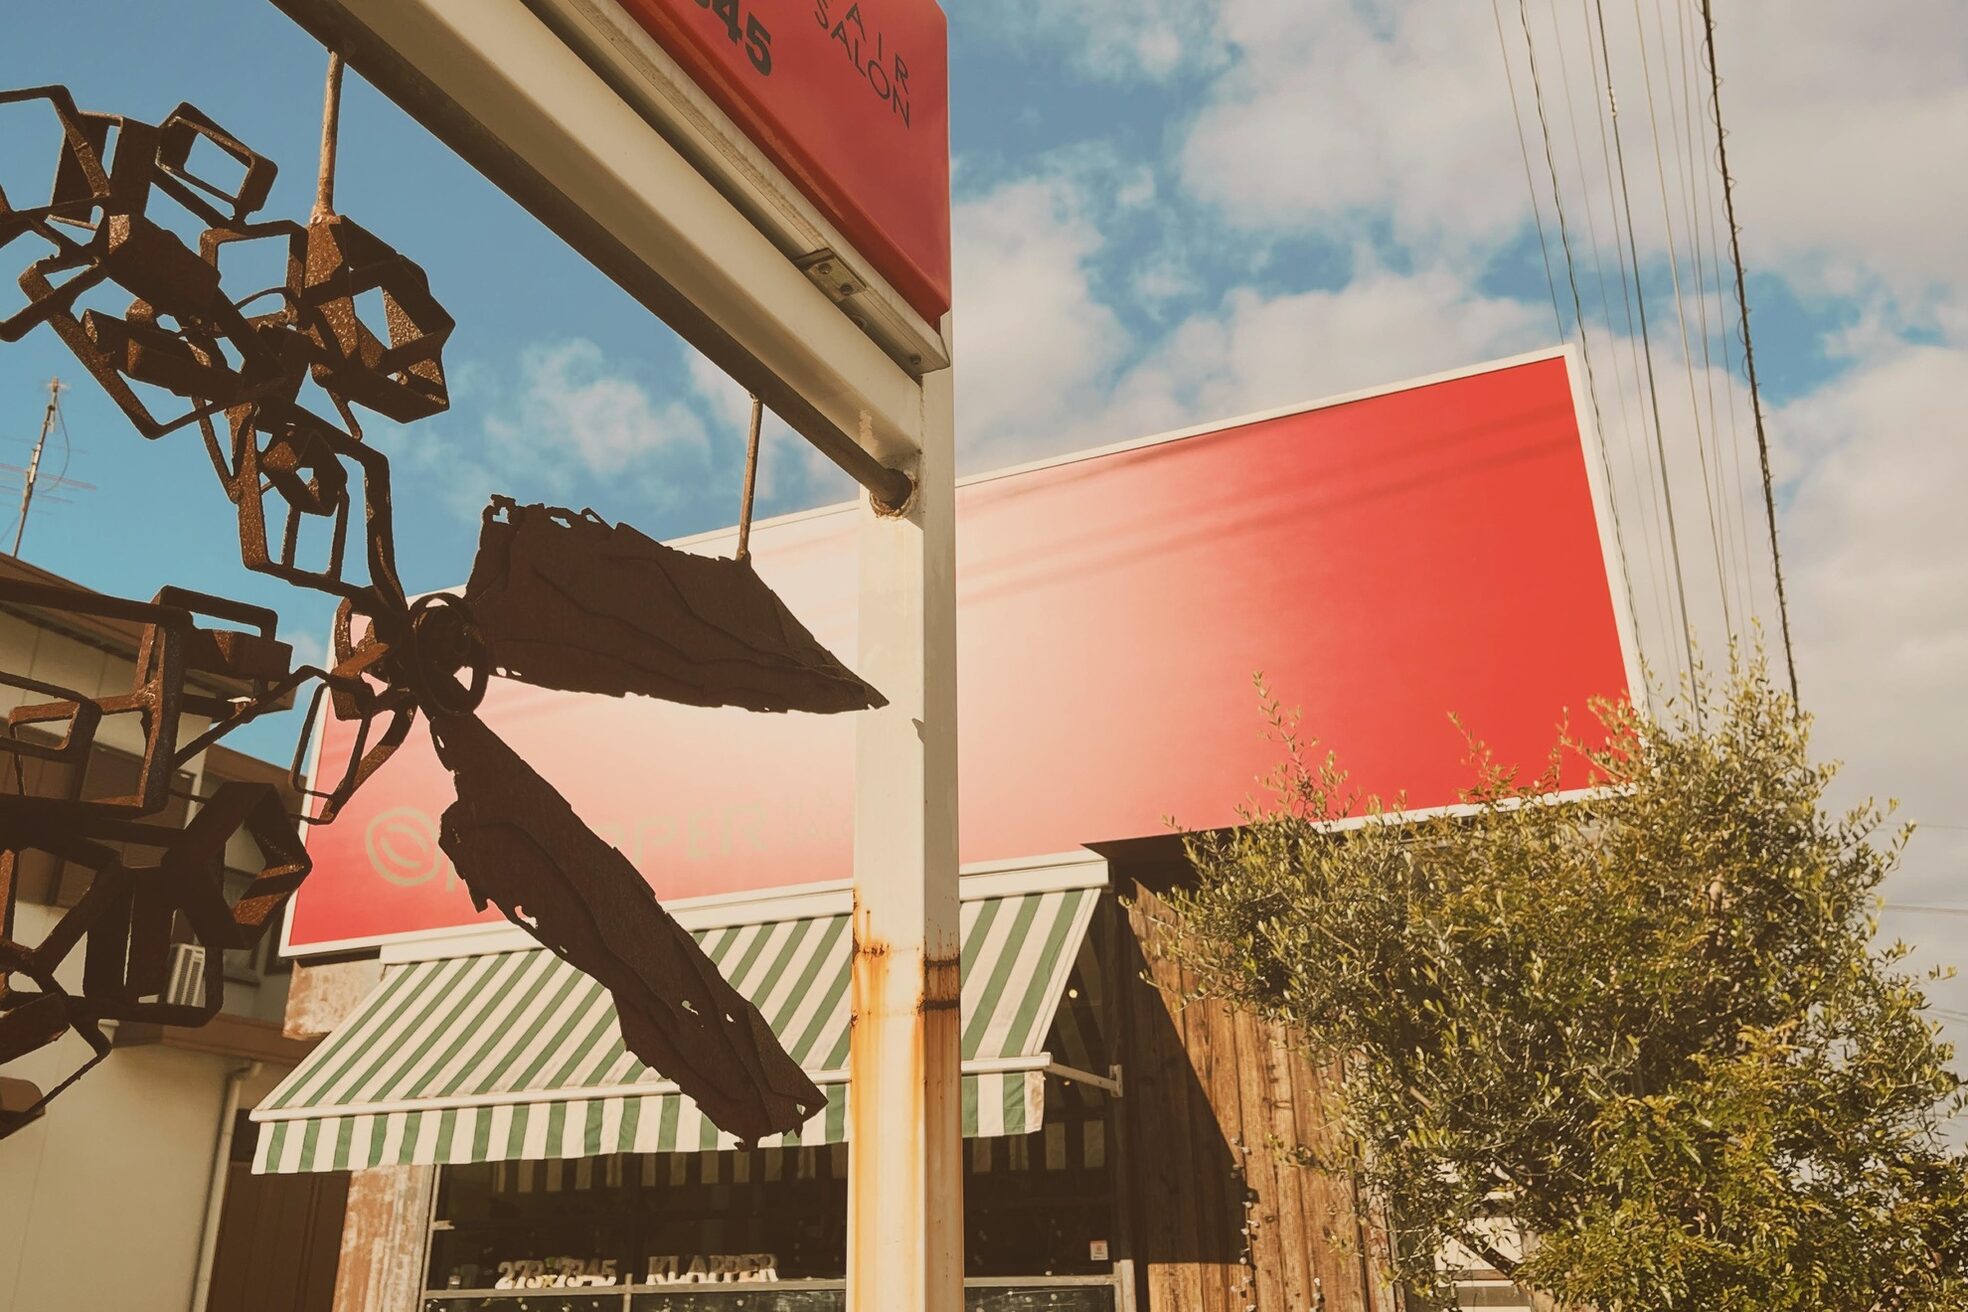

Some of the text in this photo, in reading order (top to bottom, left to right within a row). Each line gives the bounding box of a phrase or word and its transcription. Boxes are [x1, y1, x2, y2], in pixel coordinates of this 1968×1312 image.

[694, 0, 772, 76] 45
[814, 0, 910, 129] SALON
[646, 1253, 779, 1285] KLAPPER
